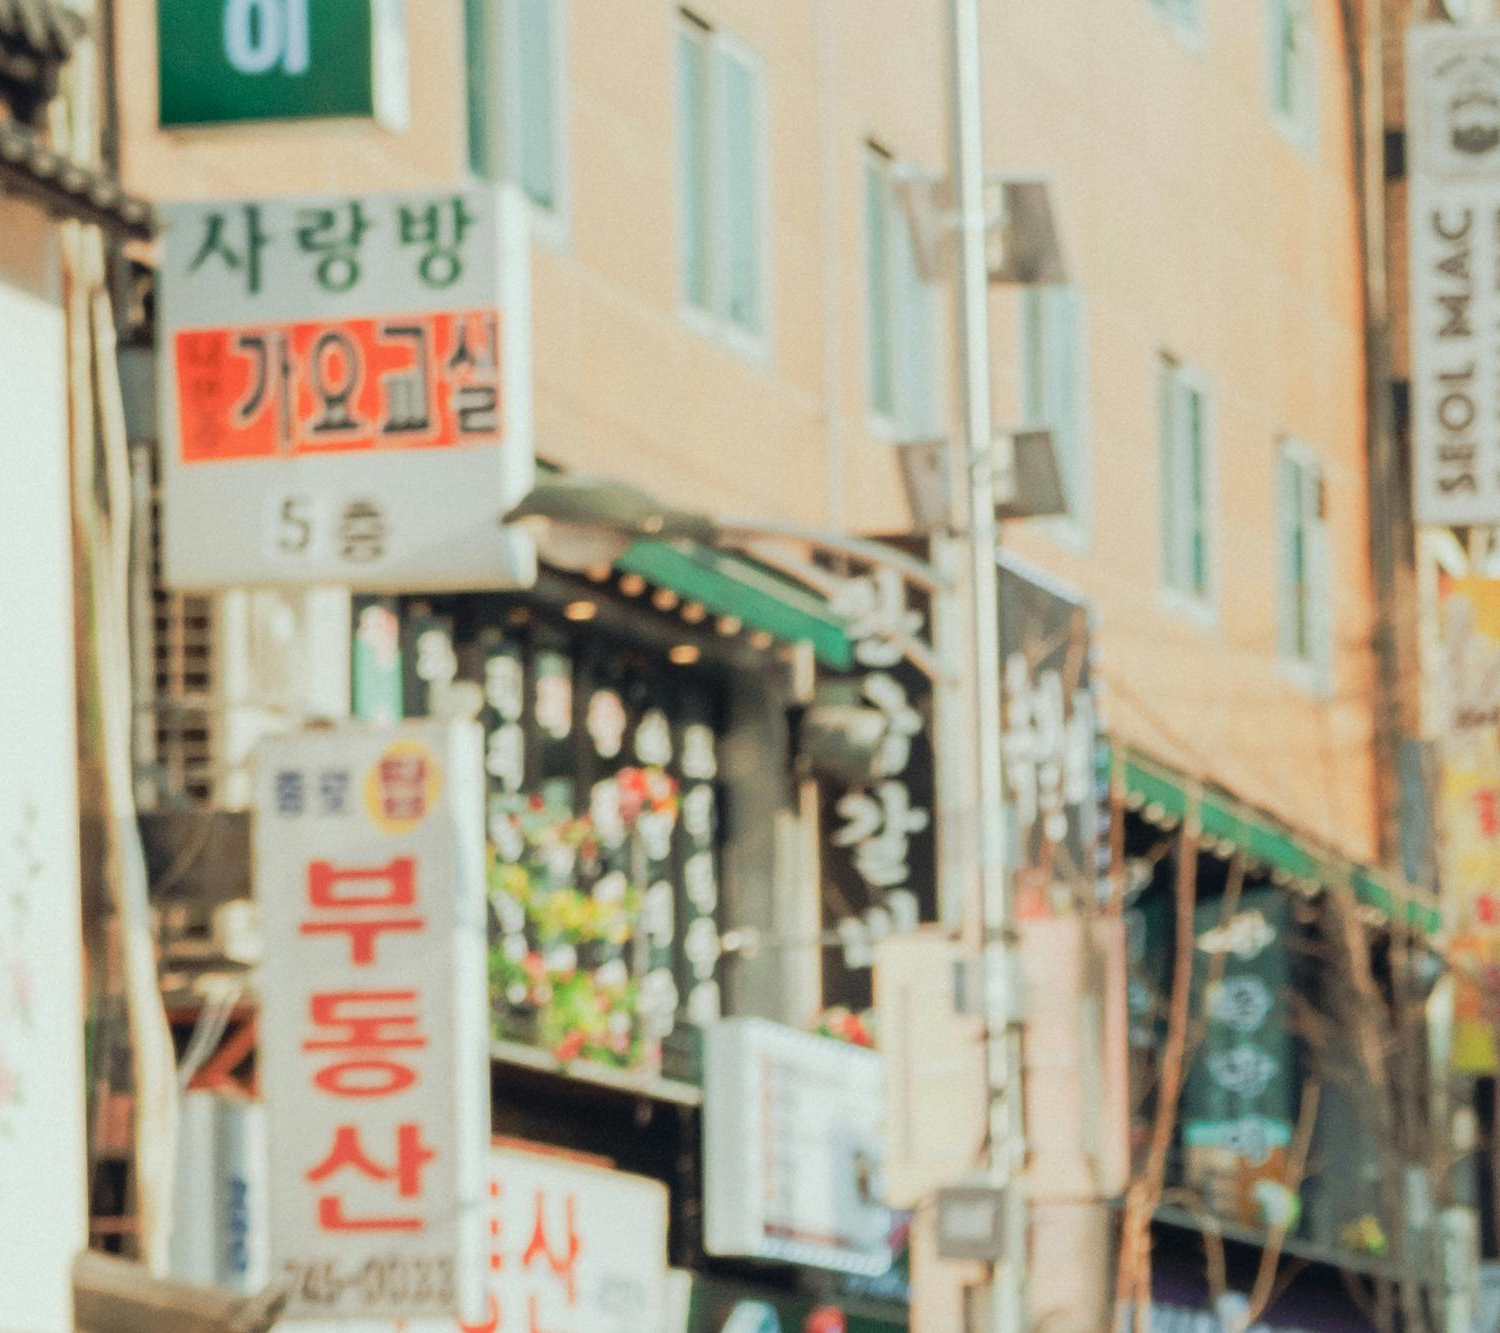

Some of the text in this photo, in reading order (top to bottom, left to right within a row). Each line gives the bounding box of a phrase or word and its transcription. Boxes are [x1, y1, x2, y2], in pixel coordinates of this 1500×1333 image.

[189, 199, 477, 293] 사랑방
[1433, 208, 1474, 340] MAC
[234, 317, 500, 447] 가요교실
[299, 856, 436, 1233] 부동산
